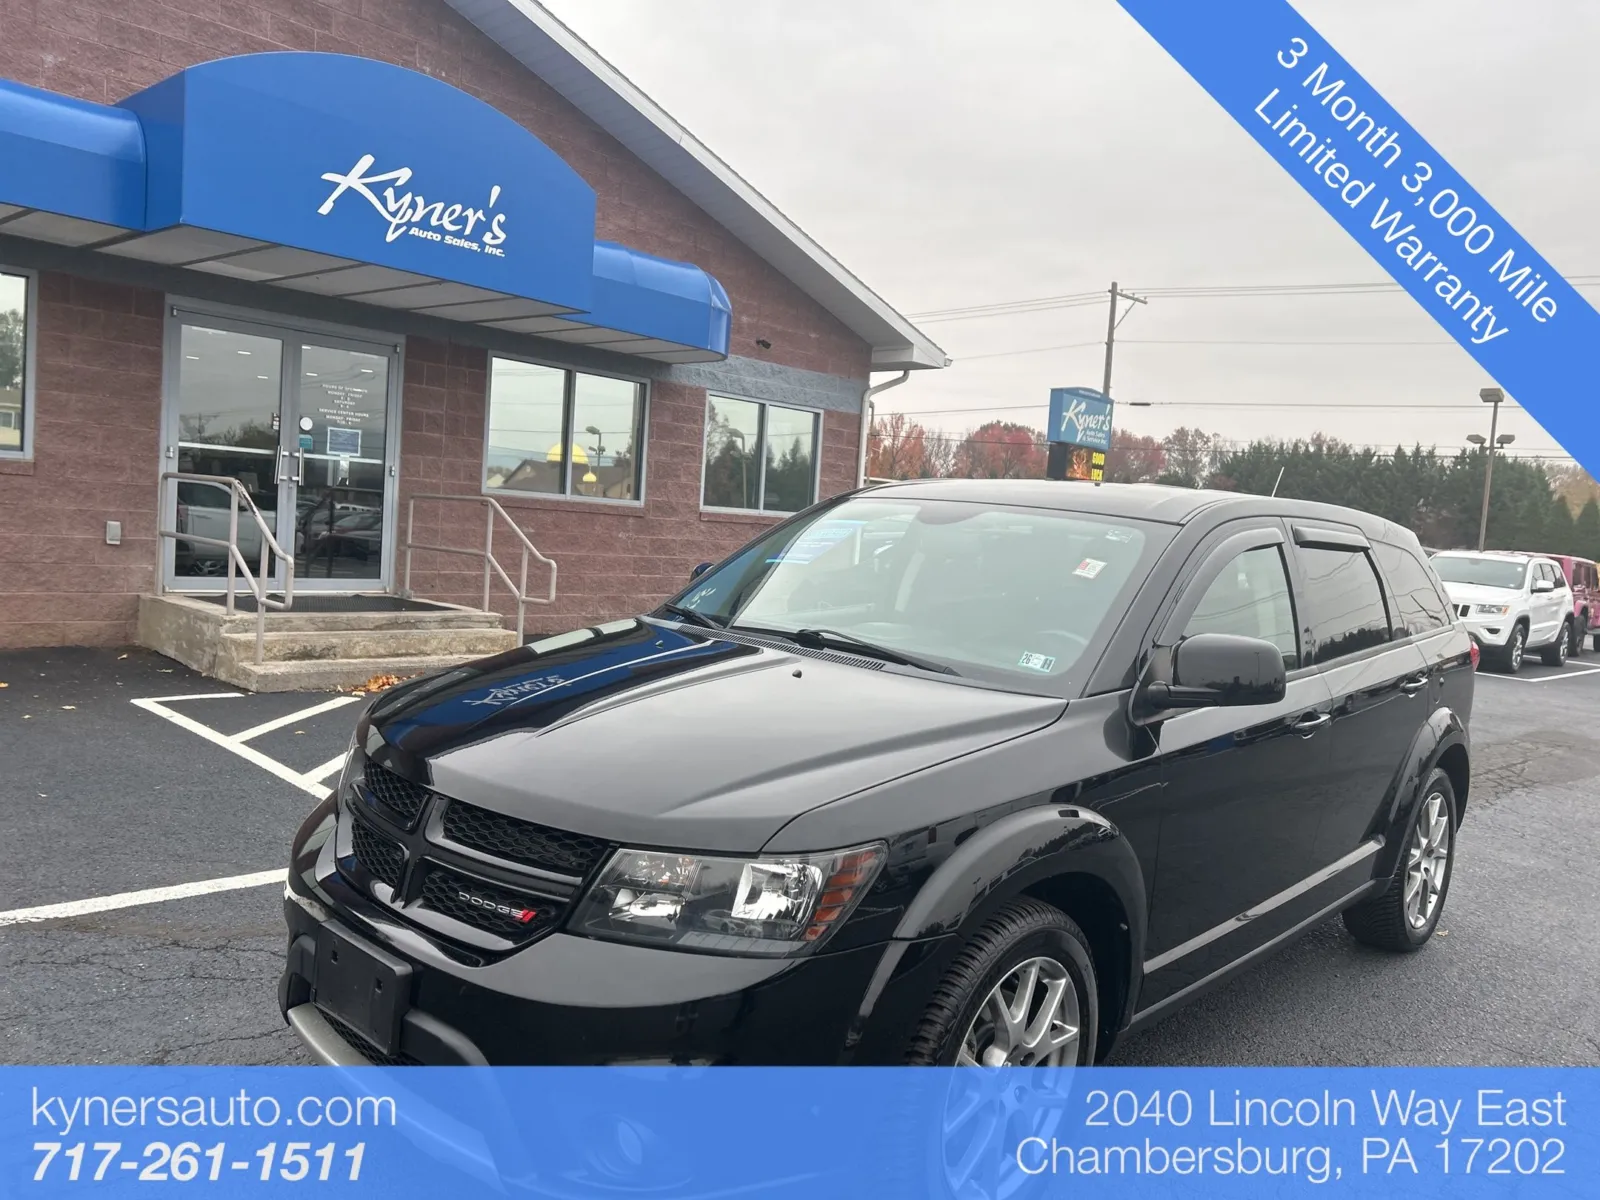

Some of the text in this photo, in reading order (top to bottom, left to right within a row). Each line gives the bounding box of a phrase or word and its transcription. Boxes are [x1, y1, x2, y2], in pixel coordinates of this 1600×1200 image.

[317, 153, 507, 245] Kyner's
[408, 226, 506, 257] Auto Sales, Inc.
[1061, 398, 1111, 443] Kyner's
[458, 891, 524, 919] DODGE
